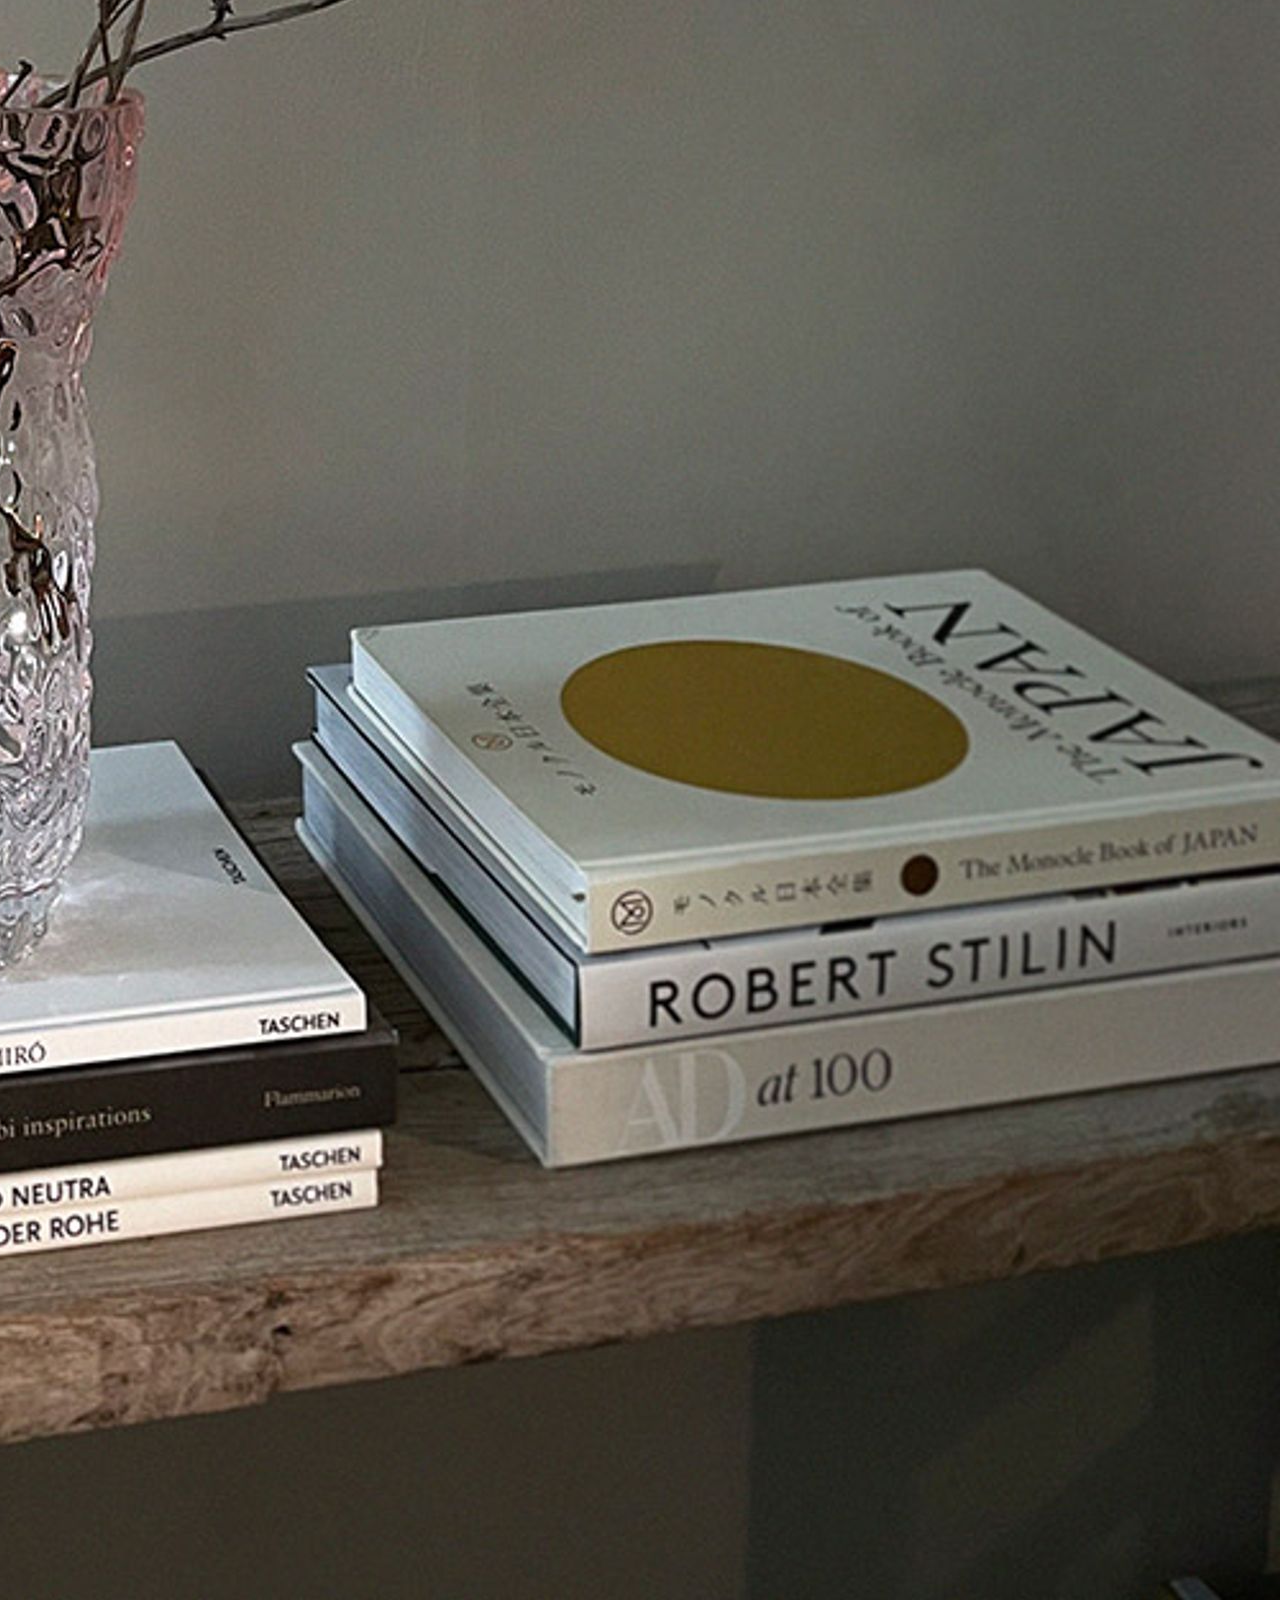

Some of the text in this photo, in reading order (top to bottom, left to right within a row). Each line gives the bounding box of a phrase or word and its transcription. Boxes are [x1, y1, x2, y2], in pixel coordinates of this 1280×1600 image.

[883, 601, 1263, 777] JAPAN
[1057, 743, 1122, 784] The
[958, 823, 1259, 880] The Monocle Book of JAPAN
[1167, 915, 1250, 938] INTERIORS
[648, 919, 1117, 1028] ROBERT STILIN
[258, 1011, 341, 1036] TASCHEN
[263, 1083, 361, 1110] Flammarion
[620, 1046, 892, 1148] AD at 100
[22, 1105, 152, 1140] inspirations
[279, 1146, 361, 1173] TASCHEN
[12, 1175, 111, 1211] NEUTRA
[270, 1181, 352, 1208] TASCHEN
[49, 1209, 120, 1240] ROHE
